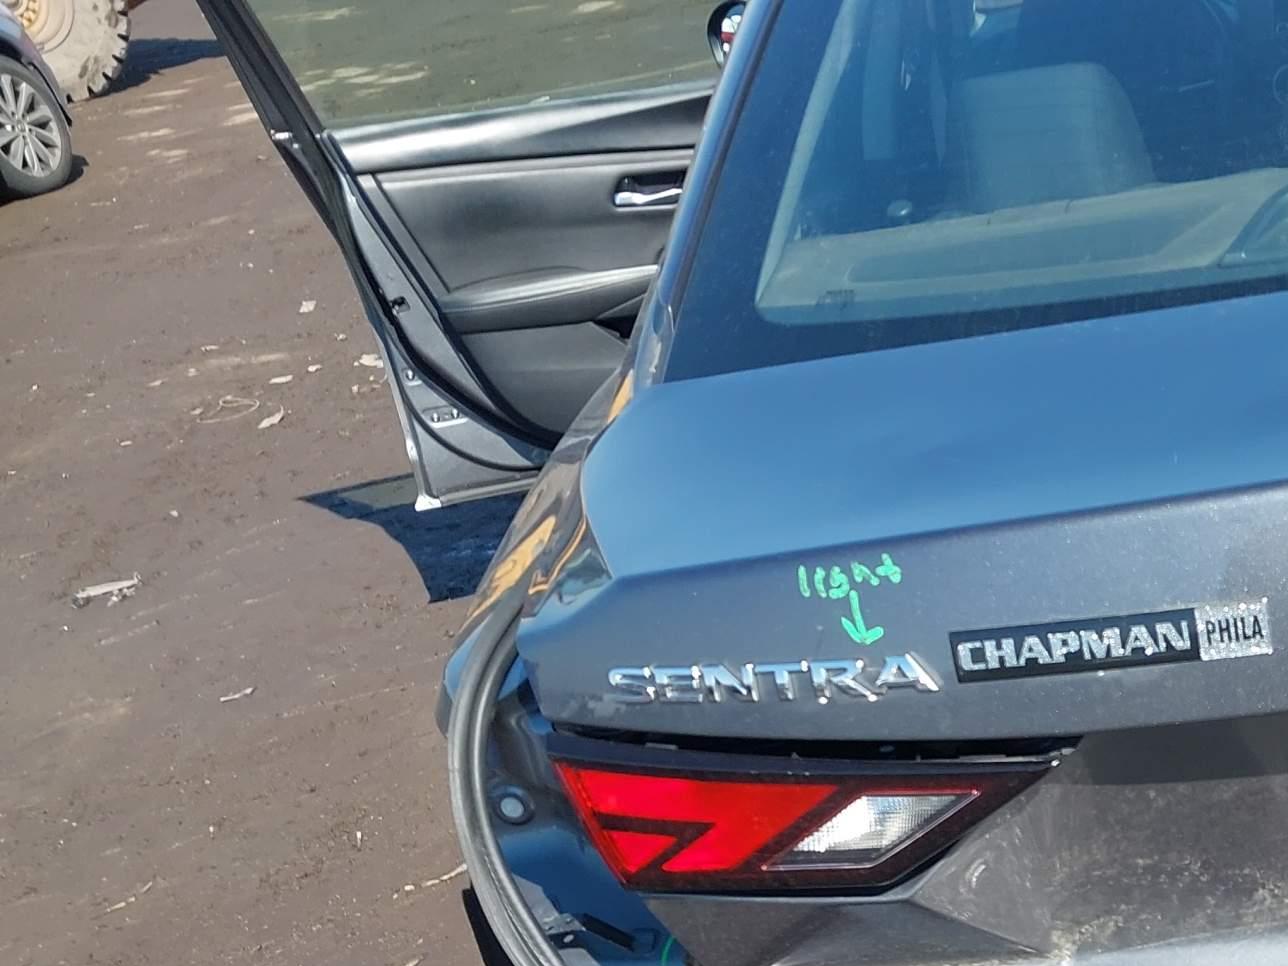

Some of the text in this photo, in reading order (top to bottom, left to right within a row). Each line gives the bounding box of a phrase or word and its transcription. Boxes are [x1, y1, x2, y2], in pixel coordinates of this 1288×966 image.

[956, 615, 1265, 672] CHAPMAN PHILA
[606, 651, 940, 704] SENTRA
